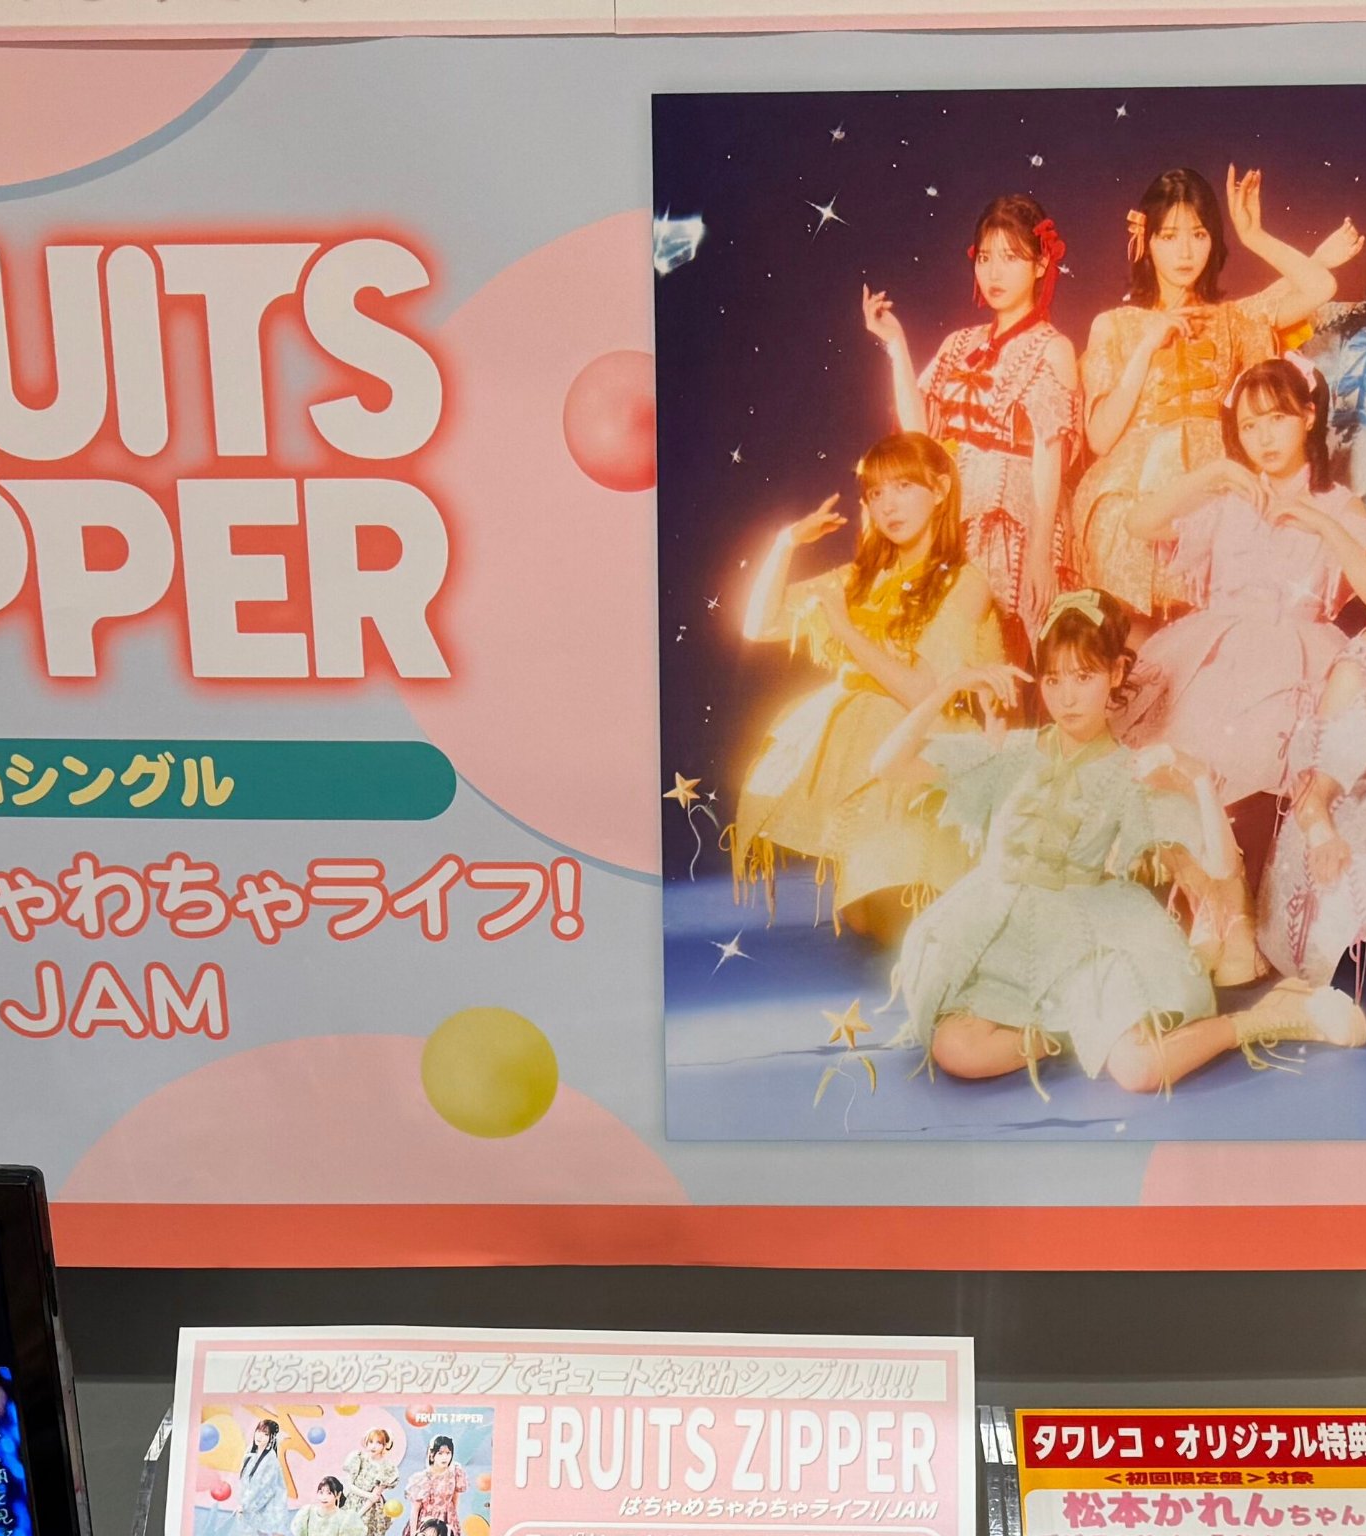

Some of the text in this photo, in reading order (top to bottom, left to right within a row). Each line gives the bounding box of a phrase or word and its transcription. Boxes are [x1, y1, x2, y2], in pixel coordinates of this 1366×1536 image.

[514, 1406, 937, 1494] FRUITS ZIPPER
[617, 1497, 937, 1520] はちゃめちゃわちゃライフ!/JAM
[1062, 1492, 1365, 1528] 松本かれんちゃん
